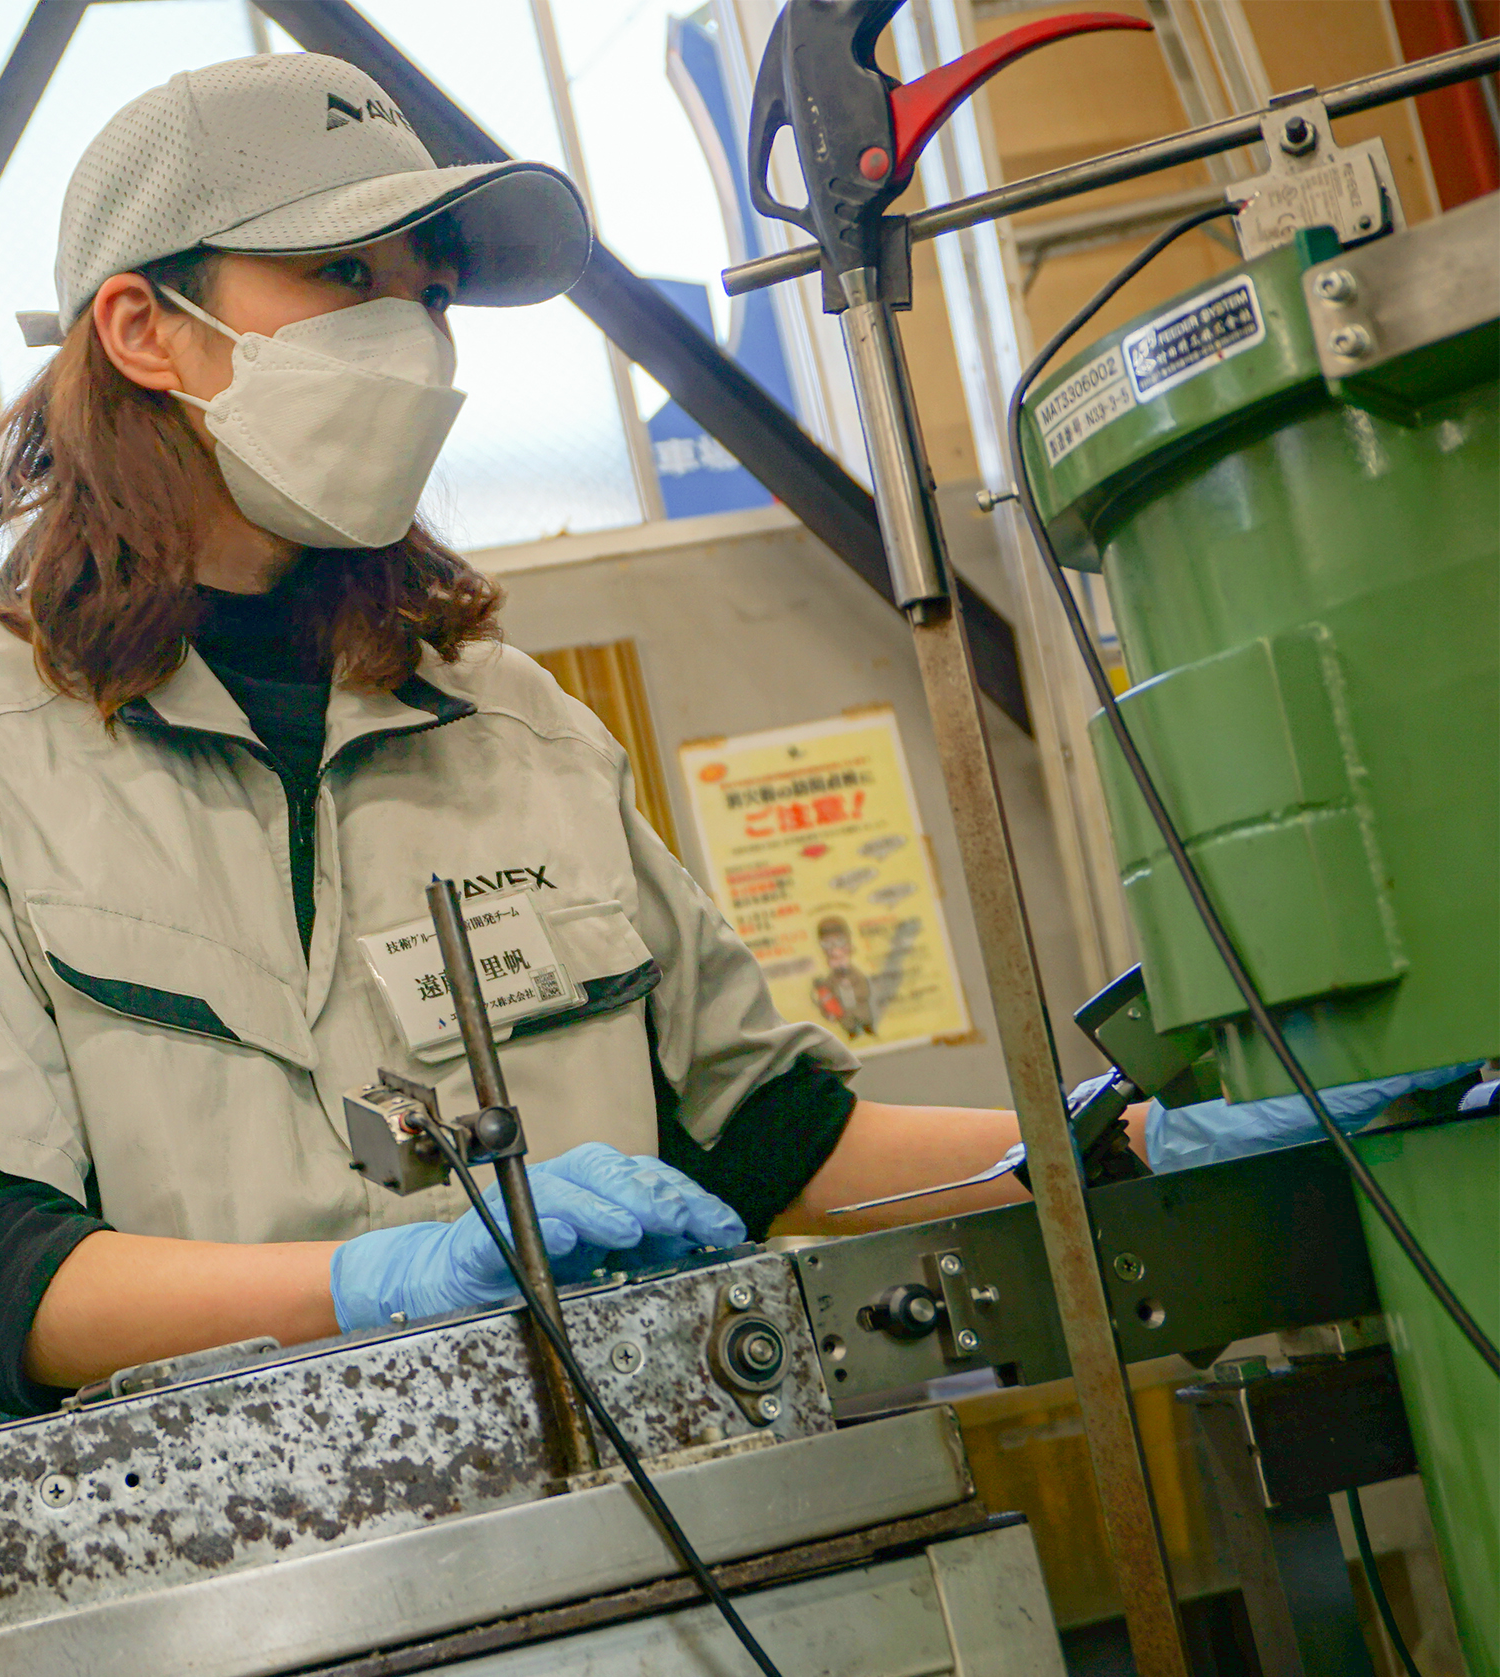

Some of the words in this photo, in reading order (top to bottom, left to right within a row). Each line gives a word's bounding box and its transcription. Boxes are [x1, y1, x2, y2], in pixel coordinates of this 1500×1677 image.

[366, 98, 417, 137] AVE
[1200, 288, 1249, 324] SYSTEM
[1041, 356, 1118, 427] MAT3306002
[462, 865, 558, 899] AVEX
